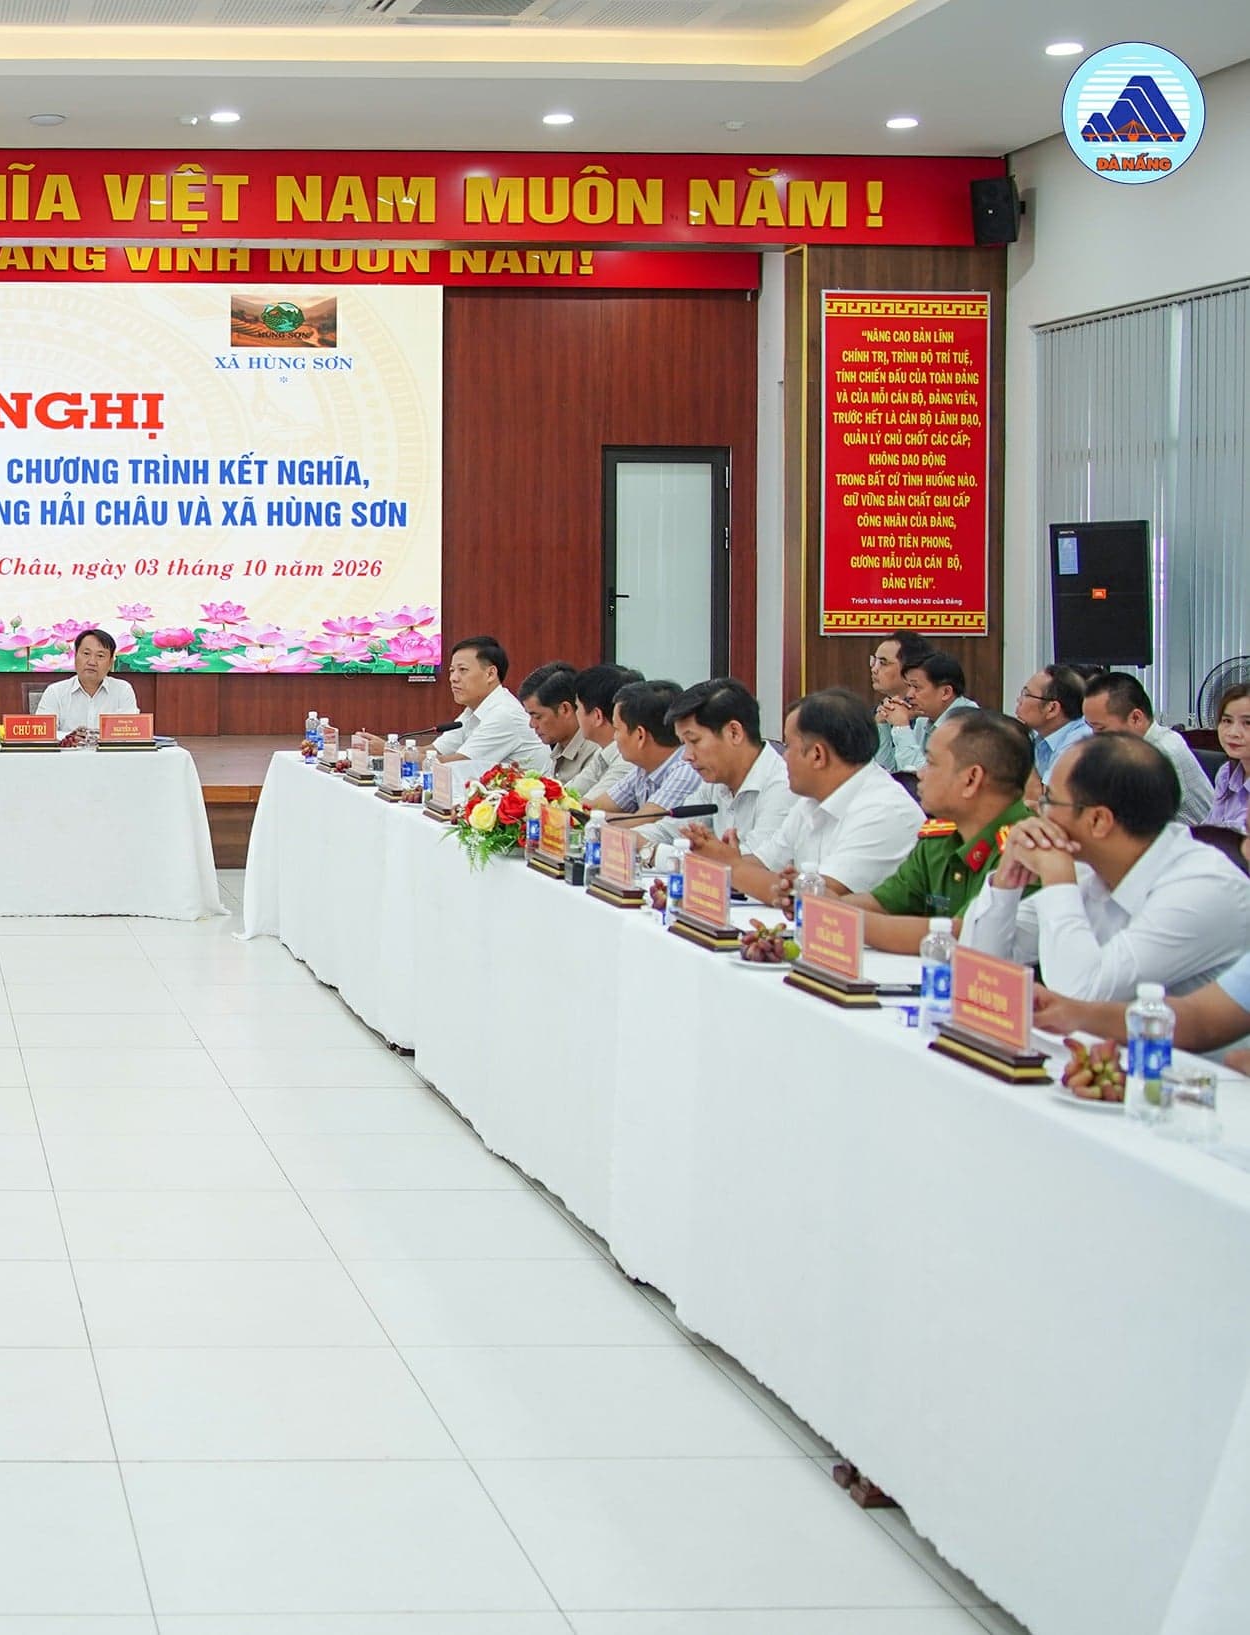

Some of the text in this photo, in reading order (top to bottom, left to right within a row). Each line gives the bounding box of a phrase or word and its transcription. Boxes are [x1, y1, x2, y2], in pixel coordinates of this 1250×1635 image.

[104, 163, 249, 232] VIỆT
[276, 175, 436, 224] NAM
[464, 165, 664, 225] MUÔN
[687, 168, 847, 227] NĂM
[124, 247, 249, 272] VINH
[862, 327, 954, 343] “NÂNG CAO BẢN LĨNH
[215, 354, 353, 369] XÃ HÙNG SƠN
[842, 348, 973, 366] CHÍNH TRỊ, TRÌNH ĐỘ TRÍ TUỆ,
[836, 367, 979, 384] TÍNH CHIẾN ĐẤU CỦA TOÀN ĐẢNG
[837, 387, 978, 407] VÀ CỦA MỖI CÁN BỘ, ĐẢNG VIÊN,
[869, 451, 946, 468] KHÔNG DAO ĐỘNG
[7, 457, 118, 484] CHƯƠNG
[129, 455, 209, 484] TRÌNH
[220, 452, 267, 485] KẾT
[278, 456, 370, 489] NGHĨA,
[41, 492, 84, 525] HẢI
[96, 496, 167, 526] CHÂU
[179, 497, 212, 526] VÀ
[222, 497, 257, 526] XÃ
[267, 497, 341, 527] HÙNG
[351, 499, 407, 527] SƠN
[861, 533, 952, 550] VAI TRÒ TIÊN PHONG,
[72, 559, 126, 579] ngày
[135, 559, 158, 575] 03
[167, 558, 234, 580] tháng
[243, 559, 266, 576] 10
[275, 560, 322, 577] năm
[332, 560, 382, 577] 2026
[882, 574, 936, 589] ĐẢNG VIÊN”.
[13, 721, 46, 735] CHỦ TRÌ
